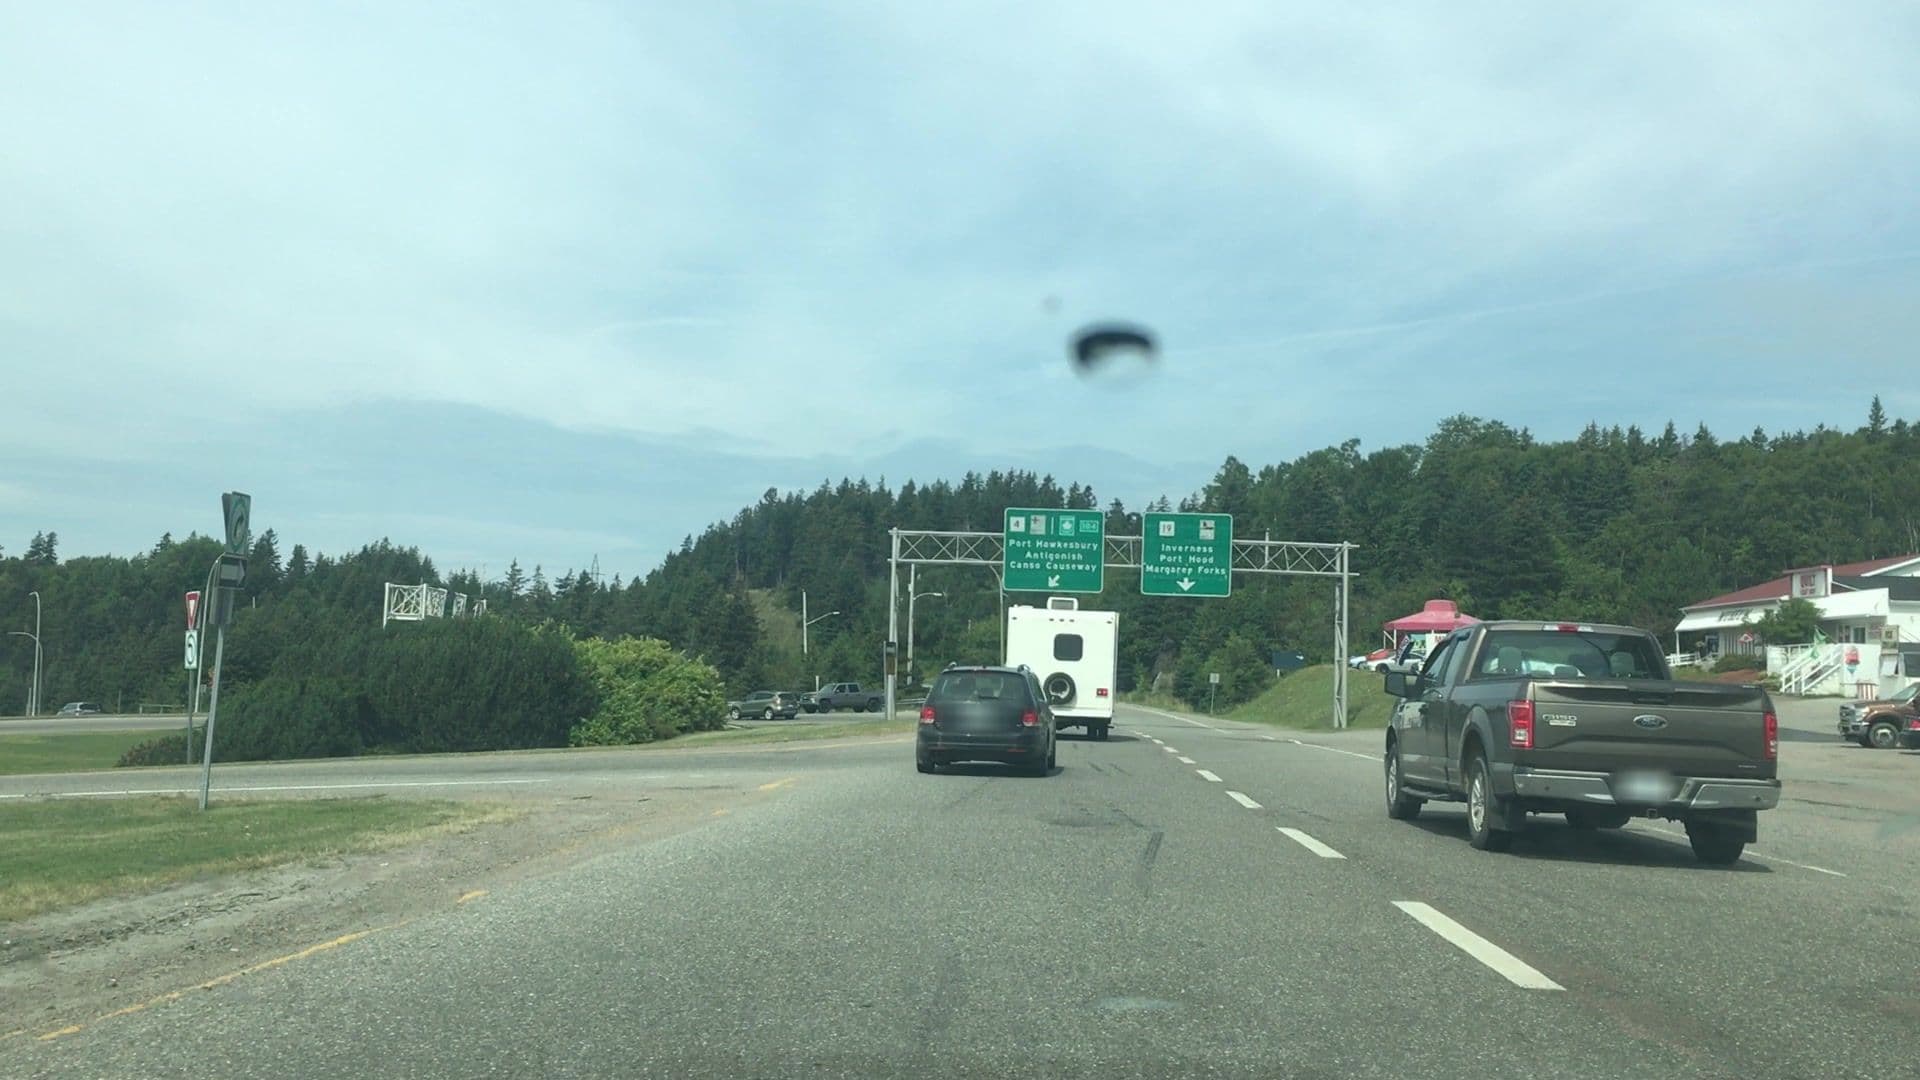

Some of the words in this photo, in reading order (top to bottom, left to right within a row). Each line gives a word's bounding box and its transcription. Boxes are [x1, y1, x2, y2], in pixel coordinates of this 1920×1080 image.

[1013, 520, 1020, 528] 4
[1009, 540, 1032, 548] Port
[1036, 540, 1098, 551] Hawkesbury
[1161, 543, 1213, 553] Inverness
[1025, 551, 1083, 562] Antigonish
[1159, 554, 1182, 563] Port
[1188, 555, 1214, 564] Hood
[1010, 561, 1041, 569] Canso
[1046, 562, 1097, 573] Causeway
[1197, 566, 1226, 575] Forks
